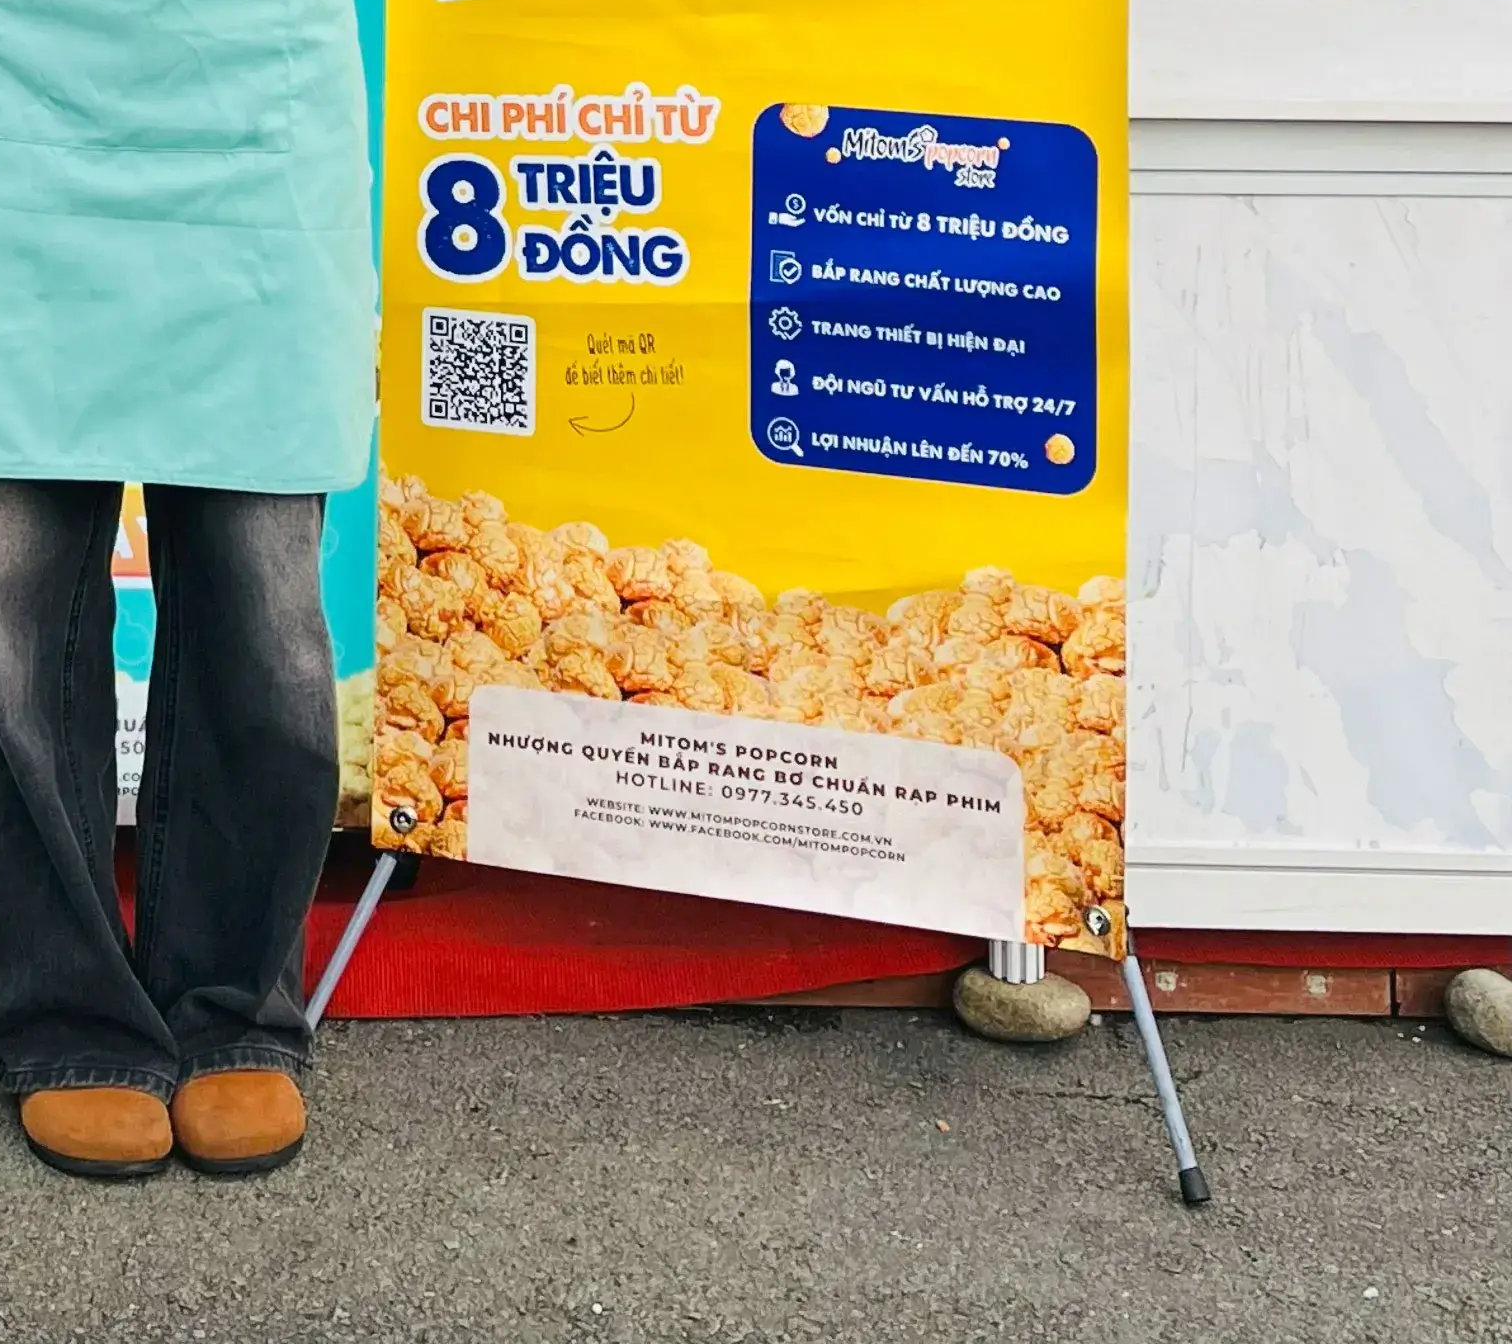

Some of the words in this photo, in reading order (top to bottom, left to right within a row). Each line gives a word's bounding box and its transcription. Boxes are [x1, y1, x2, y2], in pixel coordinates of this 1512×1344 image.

[426, 101, 489, 134] CHI
[503, 92, 567, 135] PHÍ
[578, 90, 645, 135] CHỈ
[656, 93, 713, 135] TỪ
[927, 146, 998, 169] popcorn
[958, 168, 994, 185] store
[425, 161, 506, 275] 8
[517, 151, 655, 215] TRIỆU
[813, 203, 852, 224] VỐN
[856, 208, 885, 227] CHỈ
[889, 211, 913, 229] TỪ
[917, 213, 931, 231] 8
[936, 214, 995, 240] TRIỆU
[1002, 215, 1069, 244] ĐỒNG
[523, 214, 683, 278] ĐỒNG
[812, 258, 846, 280] BẮP
[850, 268, 900, 286] RANG
[904, 269, 950, 291] CHẤT
[955, 278, 1018, 298] LƯỢNG
[1022, 284, 1061, 301] CAO
[639, 333, 656, 354] QR
[812, 321, 871, 339] TRANG
[876, 323, 921, 344] THIẾT
[927, 331, 942, 350] BỊ
[948, 331, 988, 352] HIỆN
[993, 338, 1025, 356] ĐẠI
[812, 373, 842, 395] ĐỘI
[847, 379, 886, 396] NGŨ
[890, 384, 914, 399] TƯ
[919, 383, 958, 403] VẤN
[963, 385, 988, 407] HỖ
[993, 394, 1027, 415] TRỢ
[1032, 397, 1076, 416] 24/7
[812, 432, 838, 451] LỢI
[843, 436, 907, 458] NHUẬN
[911, 440, 942, 459] LÊN
[948, 442, 983, 464] ĐẾN
[988, 449, 1029, 468] 70%
[641, 732, 726, 755] MITOM'S
[737, 745, 838, 769] POPCORN
[488, 732, 573, 755] NHƯỢNG
[709, 762, 765, 781] RANG
[947, 794, 1001, 813] PHIM
[616, 771, 713, 797] HOTLINE:
[722, 785, 863, 816] 0977.345.450
